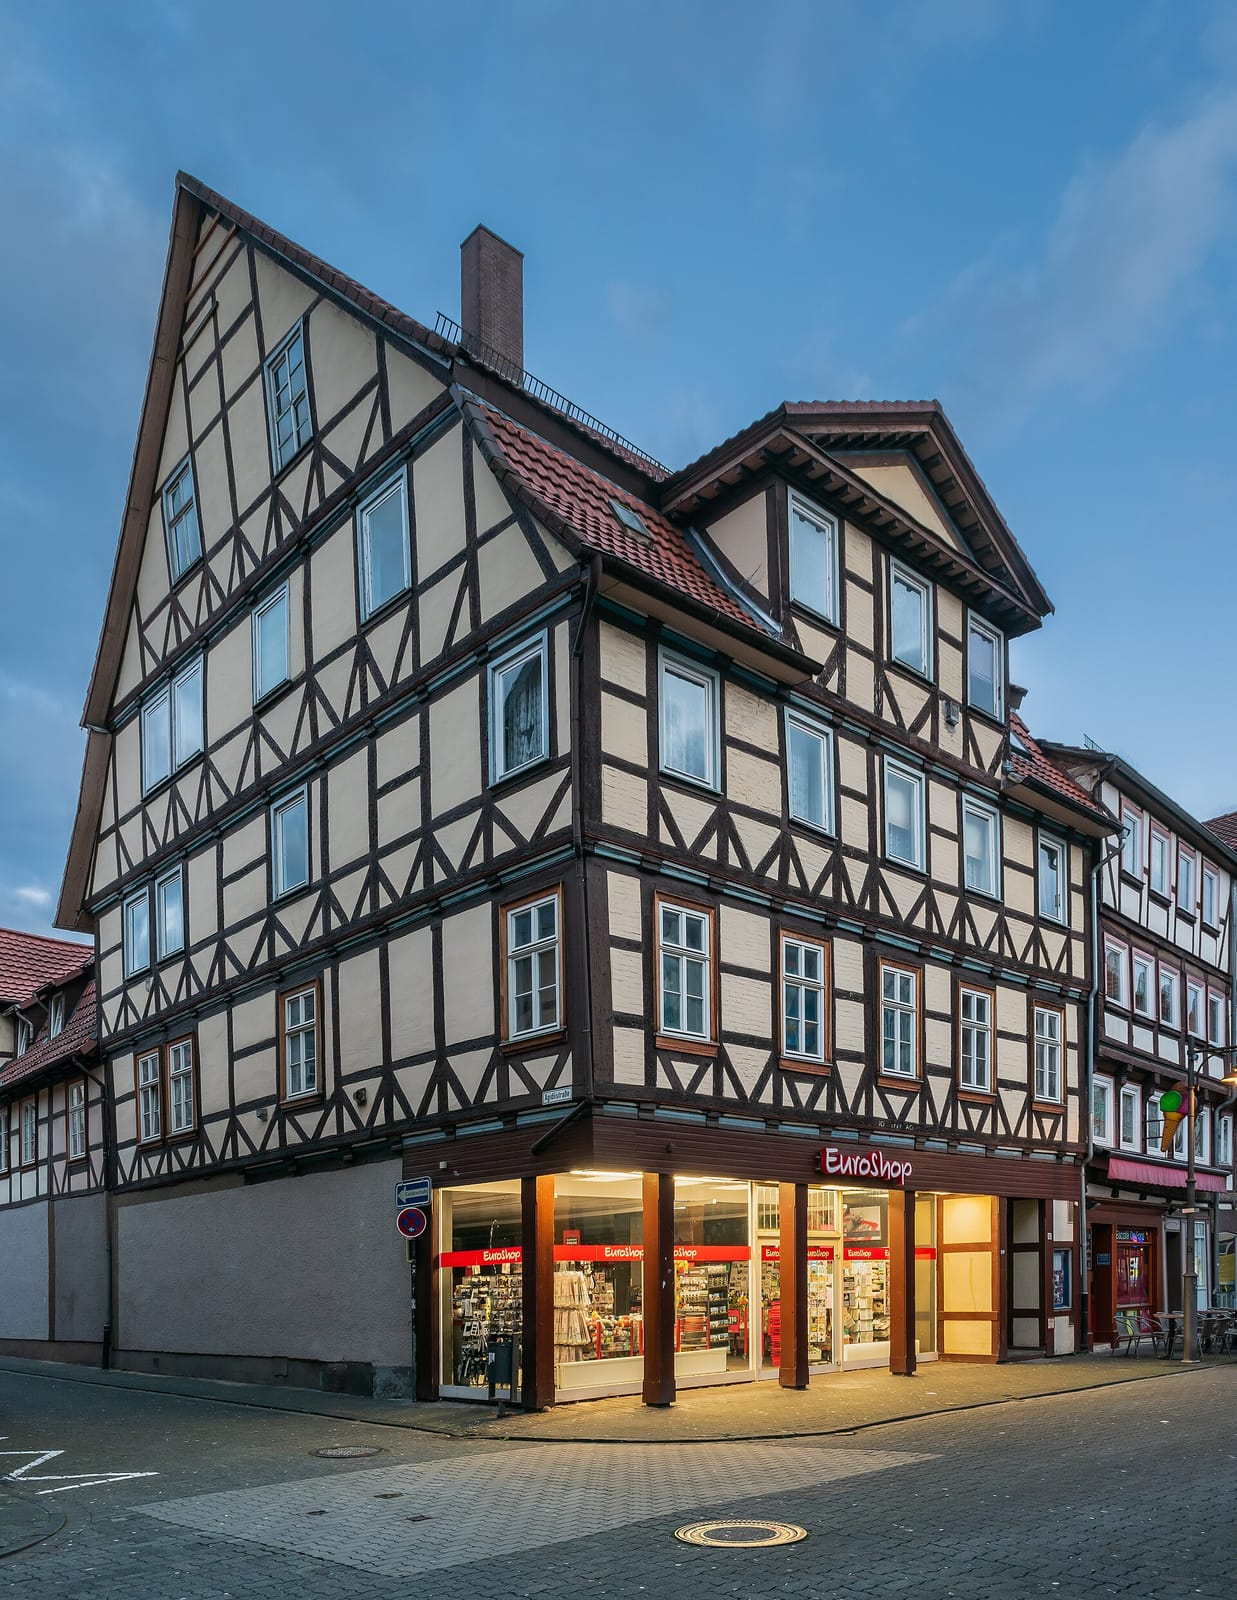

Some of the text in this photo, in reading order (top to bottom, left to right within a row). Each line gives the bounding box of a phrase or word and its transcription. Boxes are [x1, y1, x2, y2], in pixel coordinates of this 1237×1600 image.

[825, 1148, 912, 1185] EuroShop
[483, 1249, 521, 1261] EuroShop
[673, 1247, 697, 1260] oShop
[765, 1249, 780, 1257] Euro
[807, 1249, 830, 1259] uroShop
[847, 1249, 872, 1258] EuroShop
